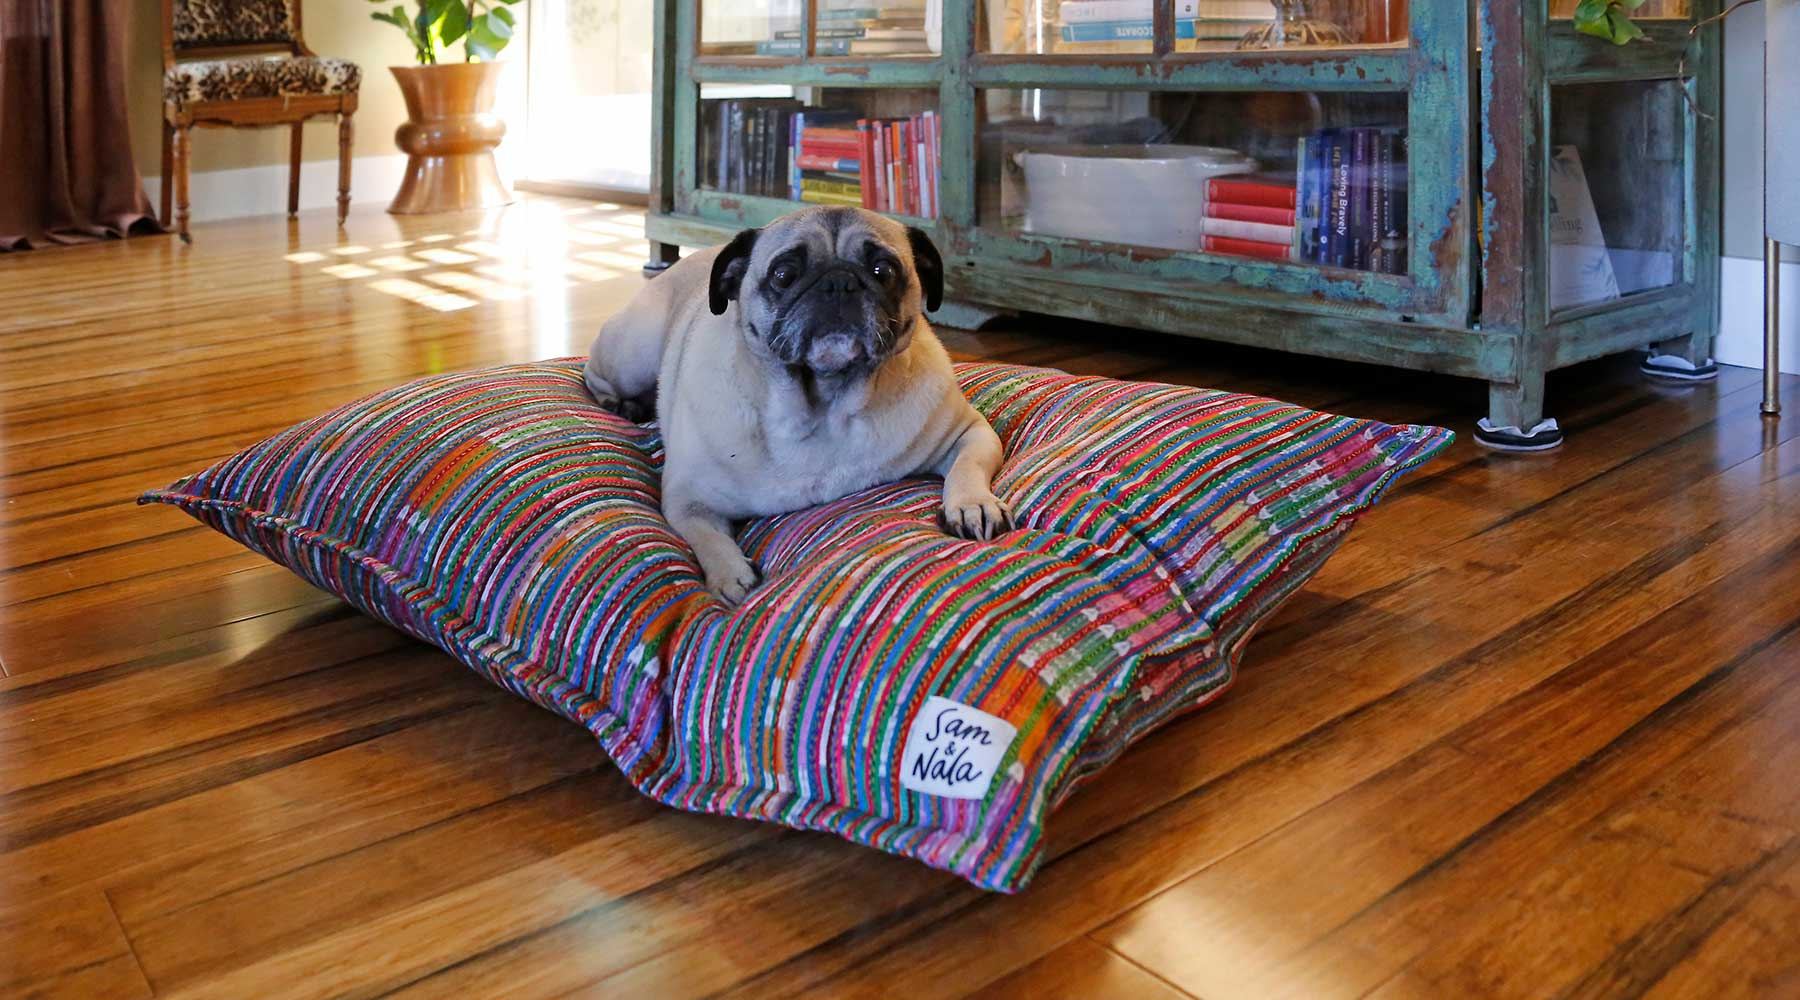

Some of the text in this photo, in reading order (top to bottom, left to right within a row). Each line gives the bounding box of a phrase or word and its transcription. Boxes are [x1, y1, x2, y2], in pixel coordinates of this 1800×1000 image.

[1115, 26, 1154, 38] ECORATE
[1336, 164, 1350, 236] Loving Bravely
[926, 708, 992, 745] Sam
[912, 747, 982, 786] Nala
[944, 741, 957, 756] &
